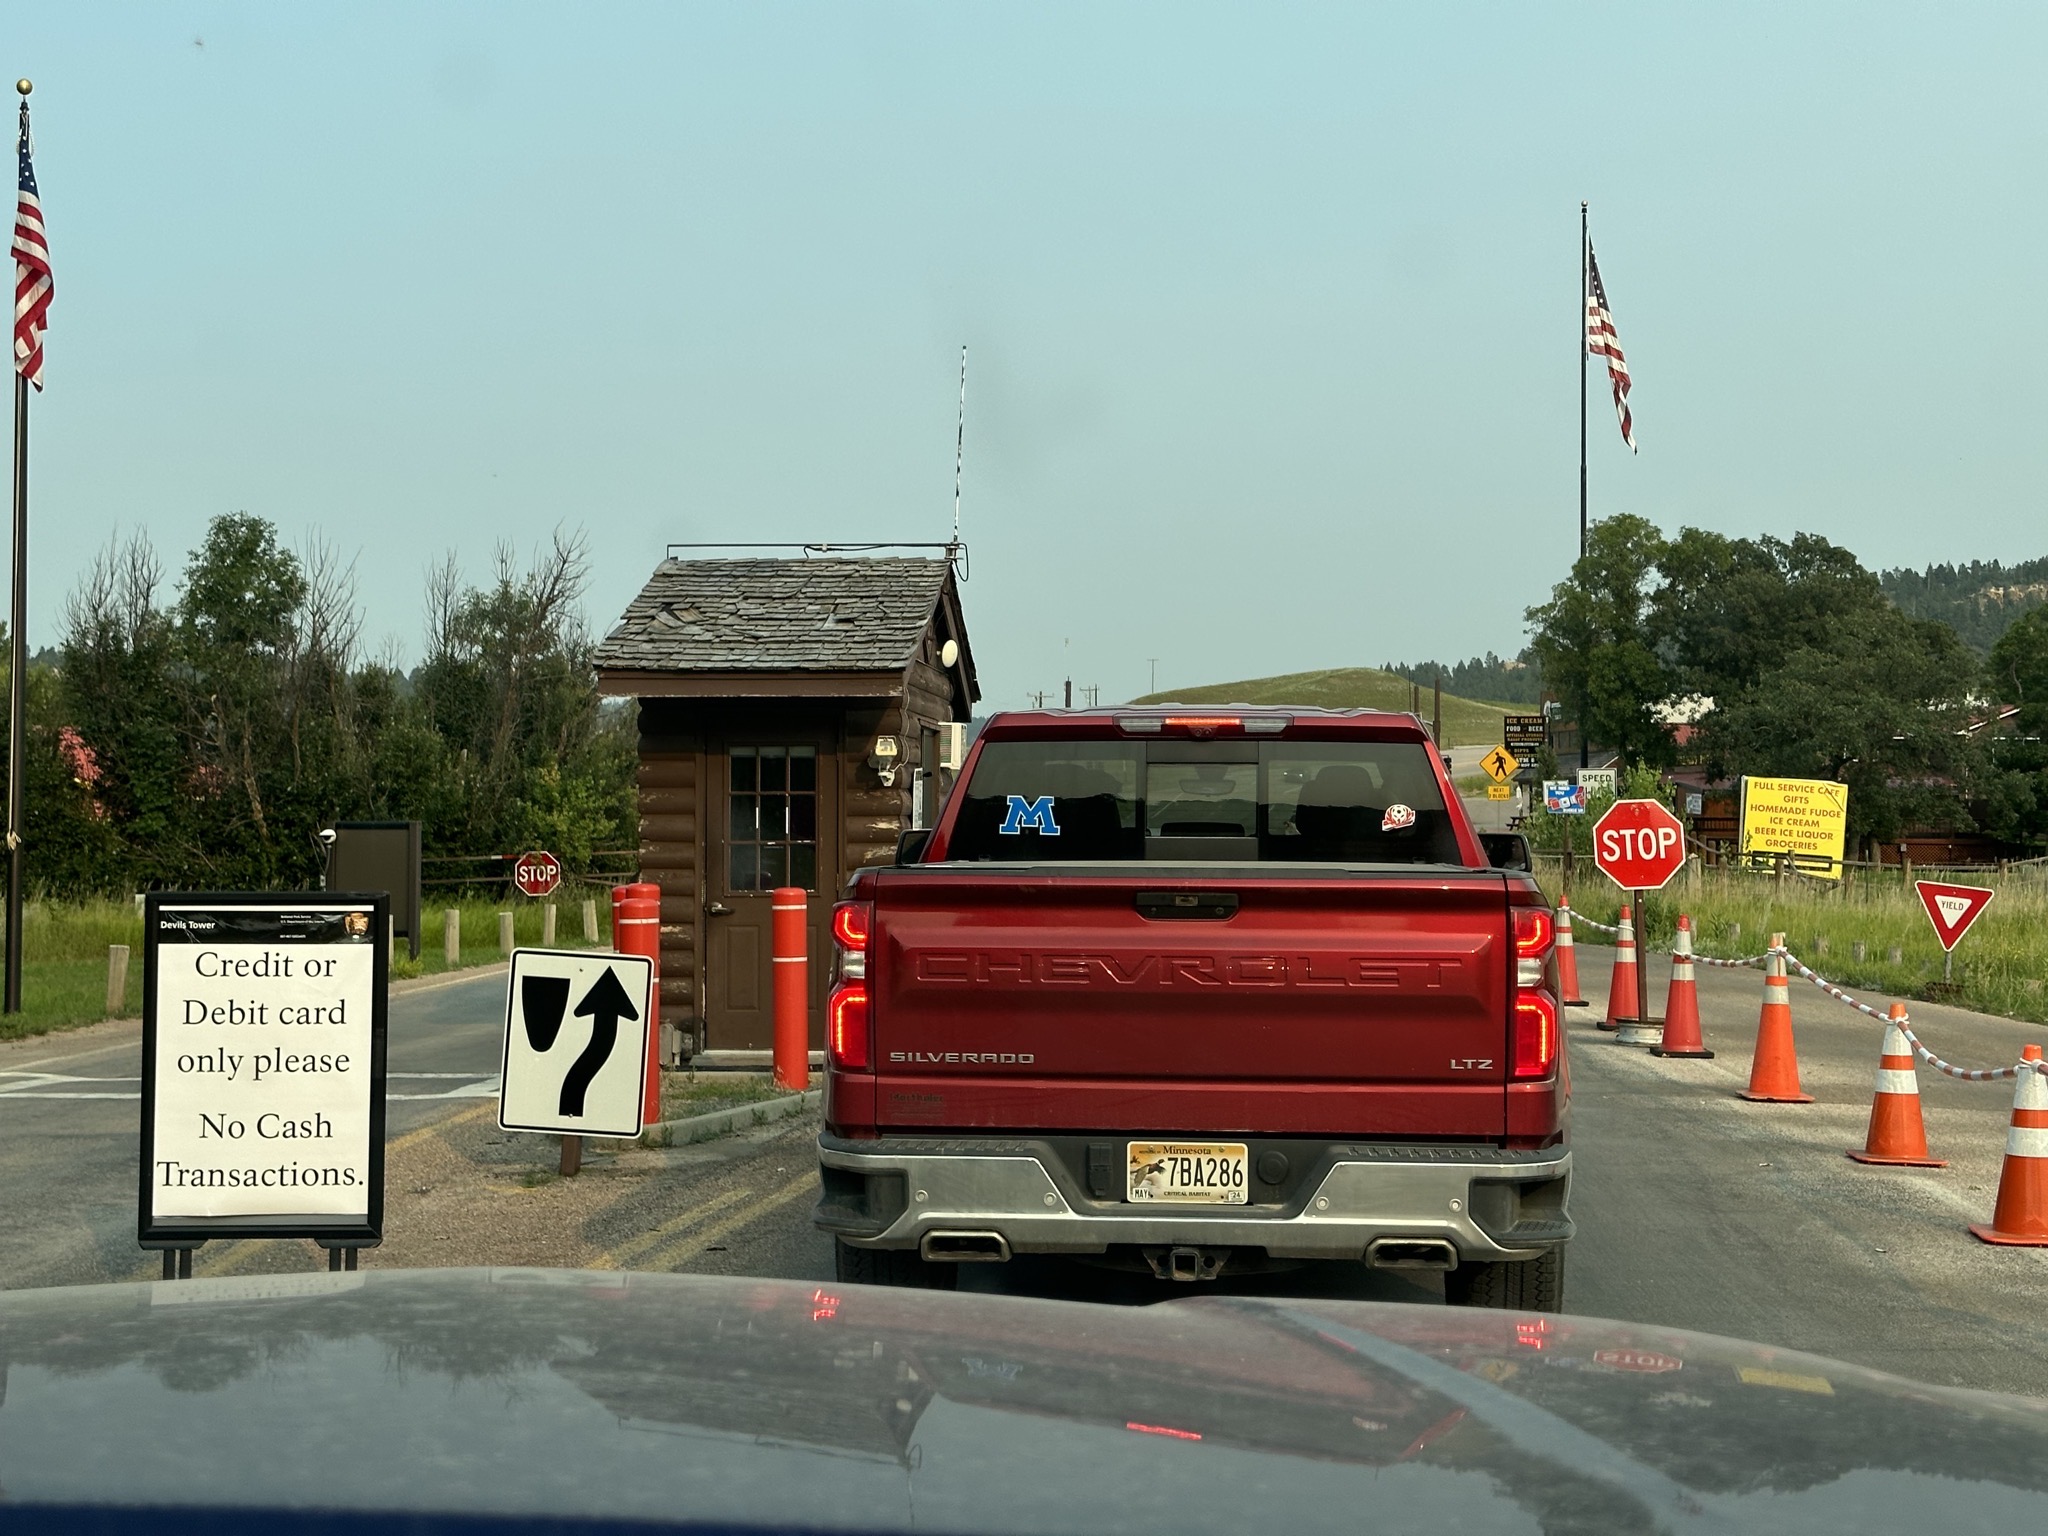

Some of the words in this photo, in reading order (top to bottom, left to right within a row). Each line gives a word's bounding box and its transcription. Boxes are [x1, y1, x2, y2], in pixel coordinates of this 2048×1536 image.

[1582, 774, 1612, 783] SPEED
[1754, 781, 1775, 791] FULL
[1777, 783, 1815, 793] SERVICE
[1817, 786, 1840, 797] CAFE
[1783, 795, 1810, 805] GIFTS
[999, 795, 1061, 835] M
[1750, 804, 1807, 816] HOMEMADE
[1809, 808, 1842, 818] FUDGE
[1769, 816, 1784, 825] ICE
[1786, 818, 1820, 828] CREAM
[1754, 826, 1777, 836] BEER
[1779, 828, 1794, 837] ICE
[1796, 829, 1834, 841] LIQUOR
[1602, 827, 1677, 862] STOP
[1765, 838, 1818, 850] GROCERIES
[519, 865, 557, 883] STOP
[1941, 900, 1964, 911] YIELD
[160, 920, 187, 930] Devils
[188, 920, 216, 930] Tower
[195, 951, 294, 978] Credit
[305, 960, 337, 978] or
[917, 953, 1462, 988] CHEVROLET
[183, 999, 269, 1026] Debit
[280, 998, 345, 1025] card
[177, 1047, 244, 1081] only
[253, 1047, 350, 1081] please
[889, 1051, 1035, 1064] SILVERADO
[1450, 1058, 1493, 1070] LTZ
[199, 1113, 245, 1139] No
[256, 1112, 333, 1139] Cash
[1163, 1145, 1212, 1155] Minnesota
[156, 1161, 364, 1188] Transactions.
[1167, 1157, 1243, 1188] 7BA286
[1134, 1188, 1148, 1199] MAY
